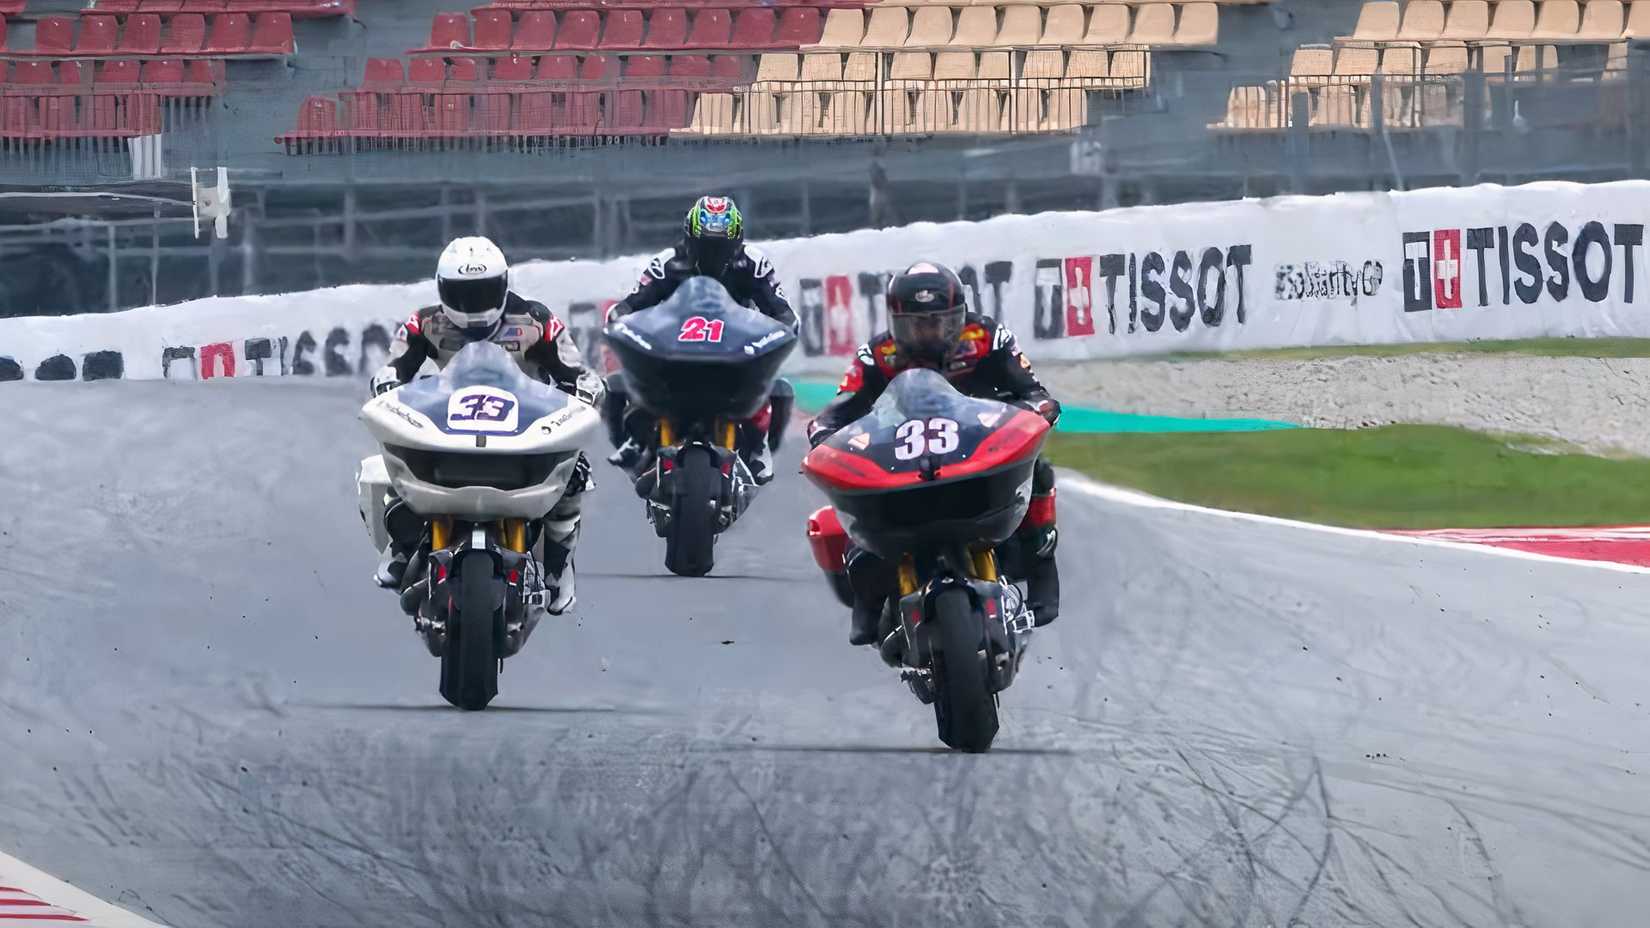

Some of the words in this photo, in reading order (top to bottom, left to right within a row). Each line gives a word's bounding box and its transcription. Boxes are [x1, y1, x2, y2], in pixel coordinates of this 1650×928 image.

[1466, 220, 1645, 307] TISSOT
[1099, 244, 1252, 335] TISSOT
[678, 316, 725, 342] 21
[450, 394, 515, 422] 33
[895, 417, 959, 461] 33
